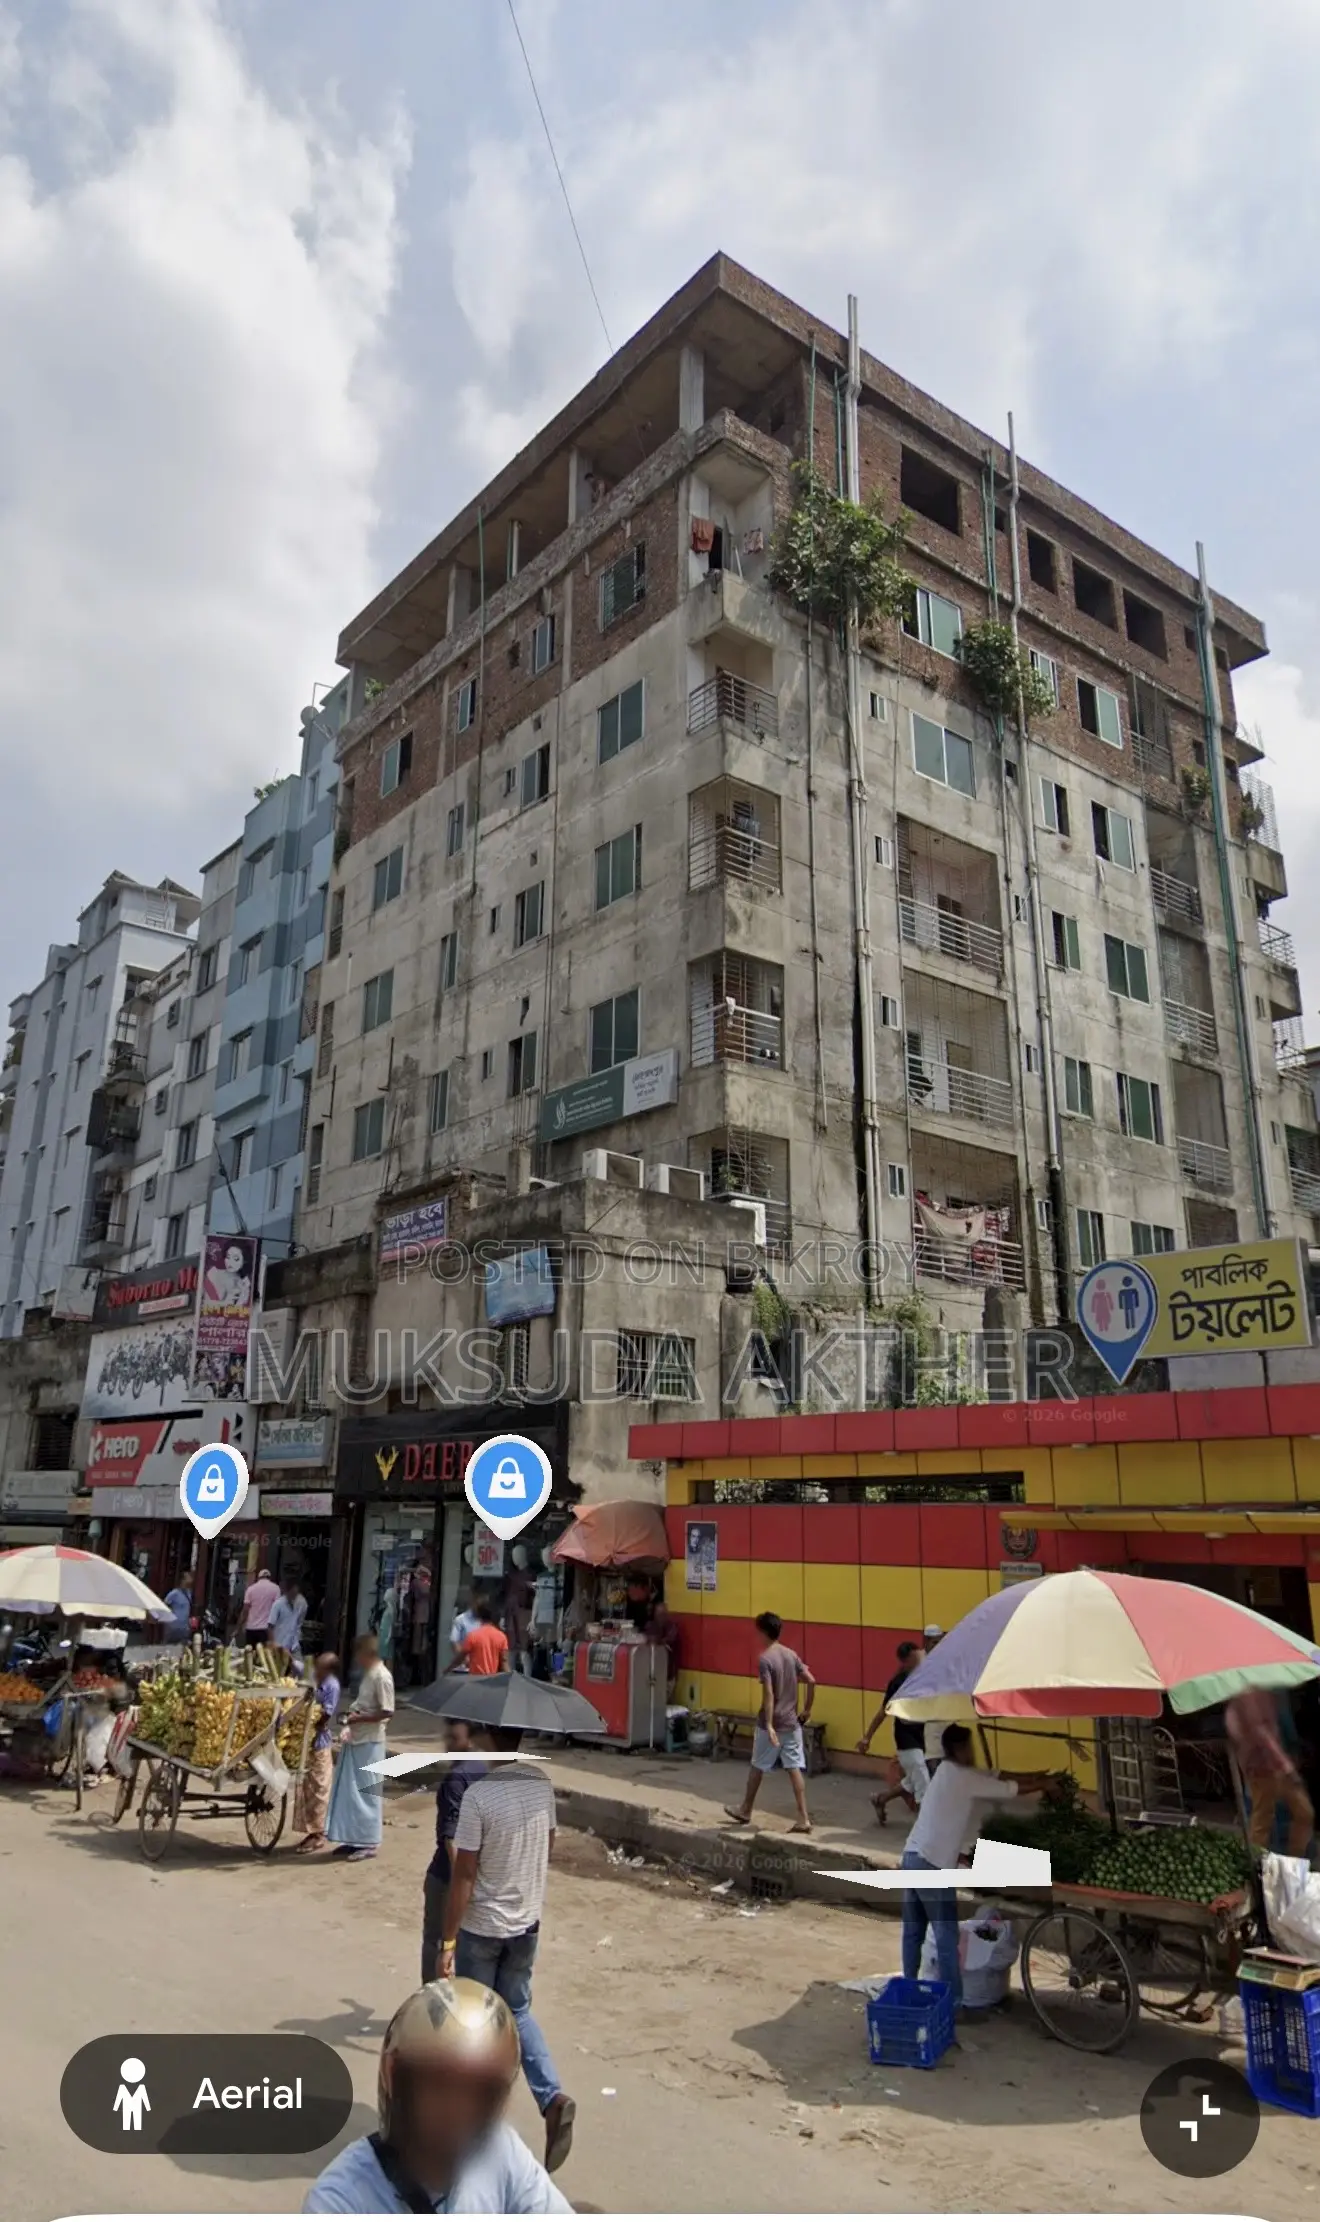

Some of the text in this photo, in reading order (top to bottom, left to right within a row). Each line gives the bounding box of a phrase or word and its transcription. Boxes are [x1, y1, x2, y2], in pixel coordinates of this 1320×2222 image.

[384, 1202, 444, 1229] ভাড়া হবে
[1181, 1253, 1269, 1289] পাবলিক
[1168, 1280, 1296, 1343] টয়লেট
